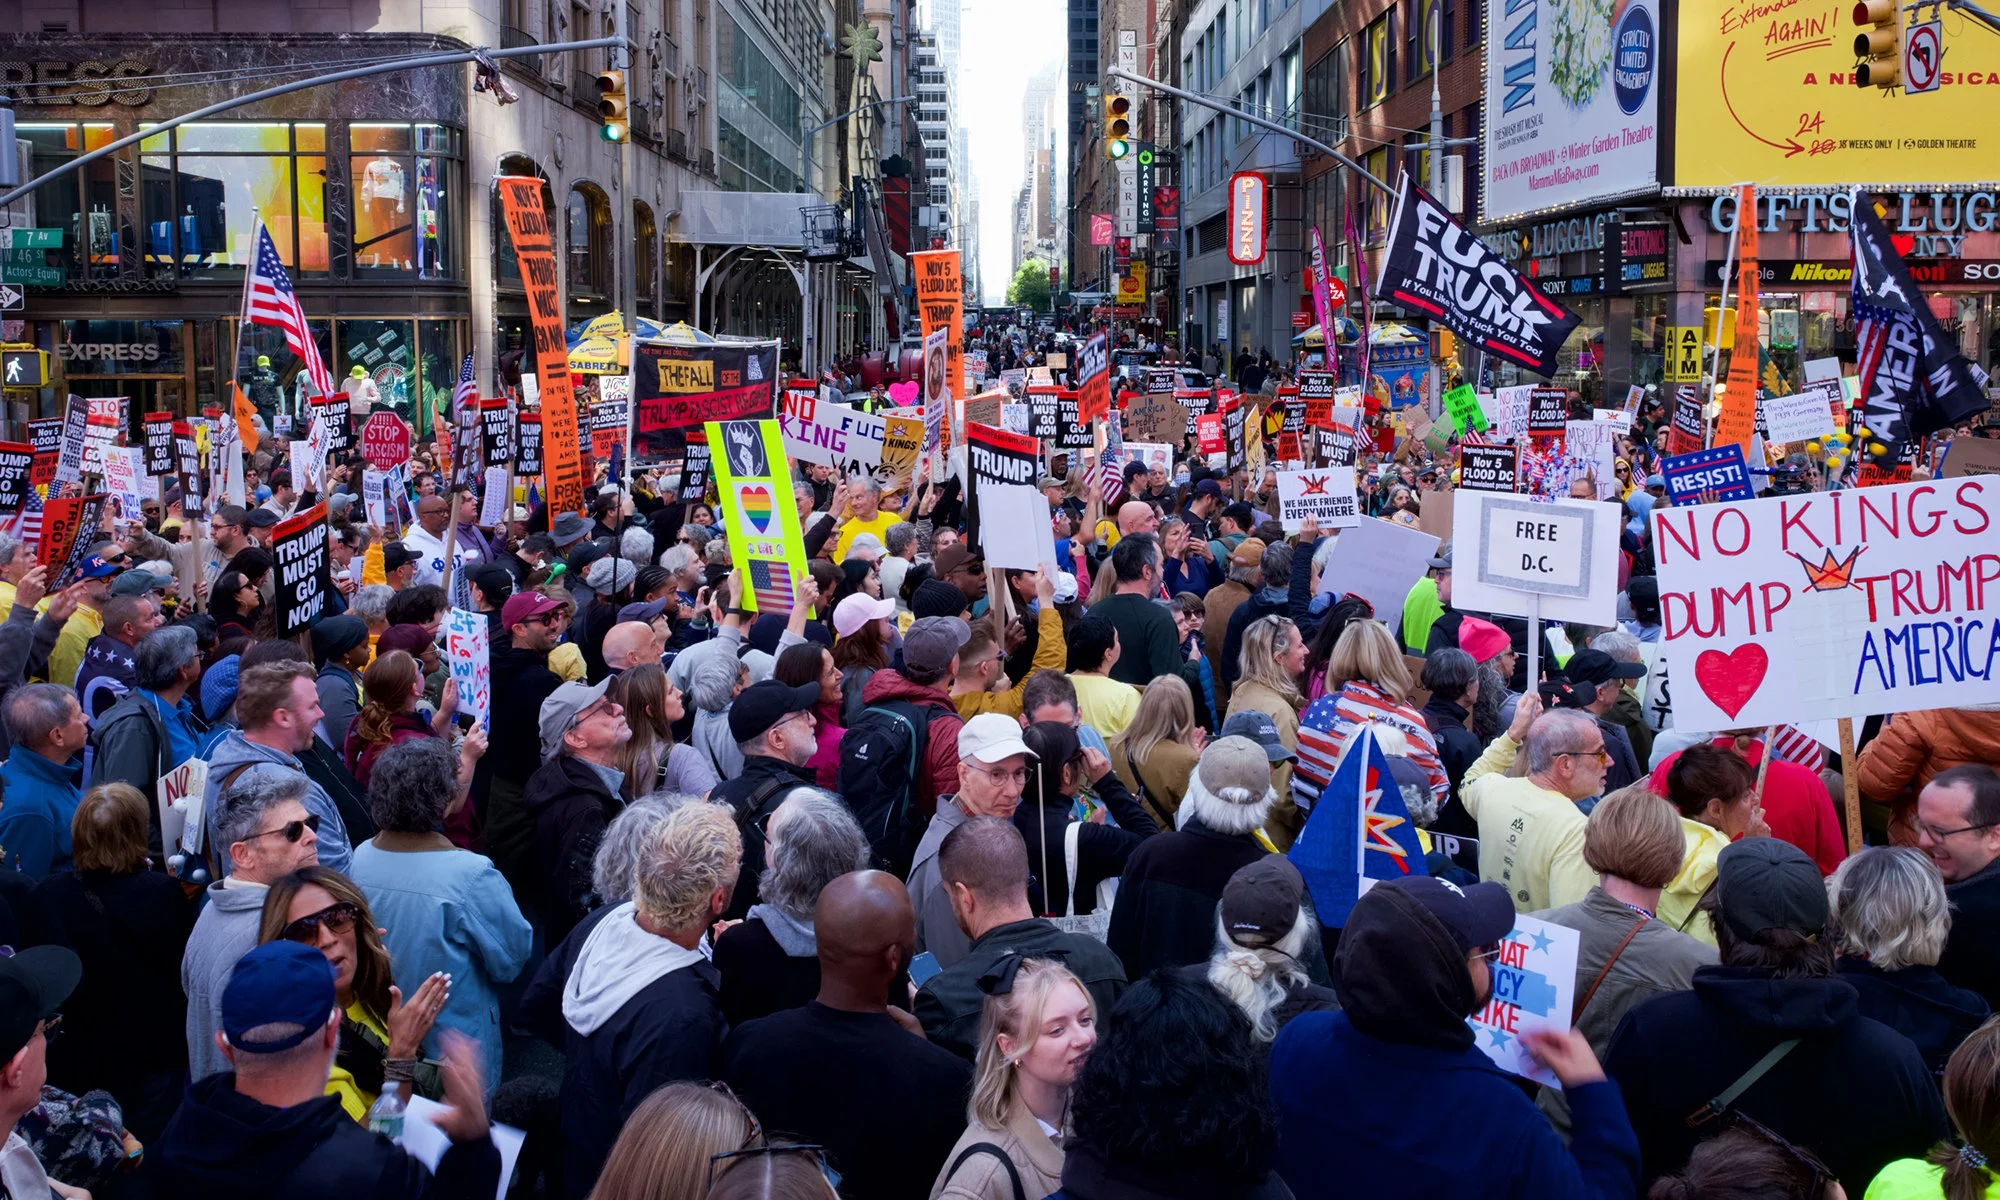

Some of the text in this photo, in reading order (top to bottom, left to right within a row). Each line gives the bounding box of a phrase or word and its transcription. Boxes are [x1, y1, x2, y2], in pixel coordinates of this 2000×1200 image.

[1764, 7, 1838, 45] AGAIN!
[1621, 30, 1650, 49] STRICTLY
[1621, 51, 1647, 68] LIMITED
[1616, 70, 1651, 89] ENGAGEMENT
[1803, 73, 1818, 85] A
[1525, 112, 1544, 130] MUSICAL
[1795, 111, 1825, 137] 24
[1849, 139, 1977, 149] WEEKS ONLY GOLDEN THEATRE
[1493, 125, 1653, 182] BACK ON BROADWAY Winter Garden Theatre
[1528, 162, 1599, 191] MammaMiaBway.com
[1240, 177, 1255, 259] PIZZA
[27, 232, 48, 246] 7 Av
[1621, 229, 1665, 257] ELECTRONICS
[1915, 235, 1967, 257] NY
[17, 249, 32, 263] 46
[36, 250, 44, 259] St
[1416, 199, 1552, 325] FUCK
[6, 266, 61, 280] Actors' Equity
[944, 261, 951, 276] 5
[1643, 262, 1665, 279] LUGGAGE
[1790, 264, 1851, 281] Nikon
[946, 278, 958, 293] DC
[1414, 241, 1543, 343] TRUMP
[1543, 278, 1592, 295] SONY BOWER
[1402, 277, 1543, 358] If You Like Trump Fuck You Too!
[589, 322, 620, 334] SABRETT
[57, 343, 159, 361] EXPRESS
[1681, 329, 1697, 374] ATM
[569, 361, 620, 371] SABRETT
[685, 365, 713, 387] FALL
[782, 390, 816, 421] NO
[1177, 399, 1209, 408] TRUMP
[1500, 391, 1510, 405] NO
[1540, 399, 1559, 409] Nov 5
[70, 410, 86, 426] FREE
[311, 402, 349, 419] TRUMP
[599, 408, 613, 416] Nov
[641, 403, 687, 426] TRUMP
[1133, 406, 1165, 416] AMERICA
[1531, 410, 1566, 420] FLOOD DC
[1689, 409, 1694, 417] 5
[592, 415, 616, 424] FLOOD
[1041, 415, 1056, 425] GO
[1691, 420, 1700, 428] DC
[38, 428, 53, 437] Nov
[147, 423, 172, 434] TRUMP
[368, 425, 399, 441] STOP
[593, 430, 613, 441] TRUMP
[776, 413, 848, 453] KING
[1070, 424, 1087, 434] GO
[1139, 424, 1156, 434] RULE
[1429, 427, 1448, 441] FEAR
[30, 437, 56, 446] FLOOD
[149, 435, 170, 447] MUST
[888, 437, 917, 450] KINGS
[1063, 433, 1093, 445] NOW!
[1201, 433, 1219, 441] ILLEGAL
[1319, 430, 1352, 448] TRUMP
[66, 440, 81, 455] FREE
[155, 448, 167, 459] GO
[364, 443, 405, 458] FASCISM
[524, 450, 535, 460] GO
[1321, 446, 1349, 461] MUST
[1484, 449, 1514, 457] Wednesday,
[62, 453, 80, 469] PRESS
[85, 450, 100, 461] GO
[1473, 457, 1502, 467] Nov 5
[151, 459, 171, 471] NOW!
[519, 461, 538, 472] NOW!
[686, 459, 708, 471] MUST
[972, 446, 1033, 482] TRUMP
[690, 474, 702, 485] GO
[1463, 468, 1514, 480] FLOOD DC
[1670, 465, 1743, 493] RESIST!
[1860, 466, 1894, 479] TRUMP
[1495, 482, 1513, 490] protest
[122, 493, 135, 506] NOT
[1284, 496, 1353, 508] WE HAVE FRIENDS
[1515, 521, 1557, 542] FREE
[1656, 507, 1750, 564] NO
[275, 523, 327, 565] TRUMP
[283, 547, 324, 586] MUST
[1521, 553, 1554, 573] D.C.
[296, 575, 316, 602] GO
[1855, 554, 2000, 623] TRUMP
[288, 594, 324, 630] NOW!
[1660, 581, 1792, 641] DUMP
[165, 765, 190, 807] NO
